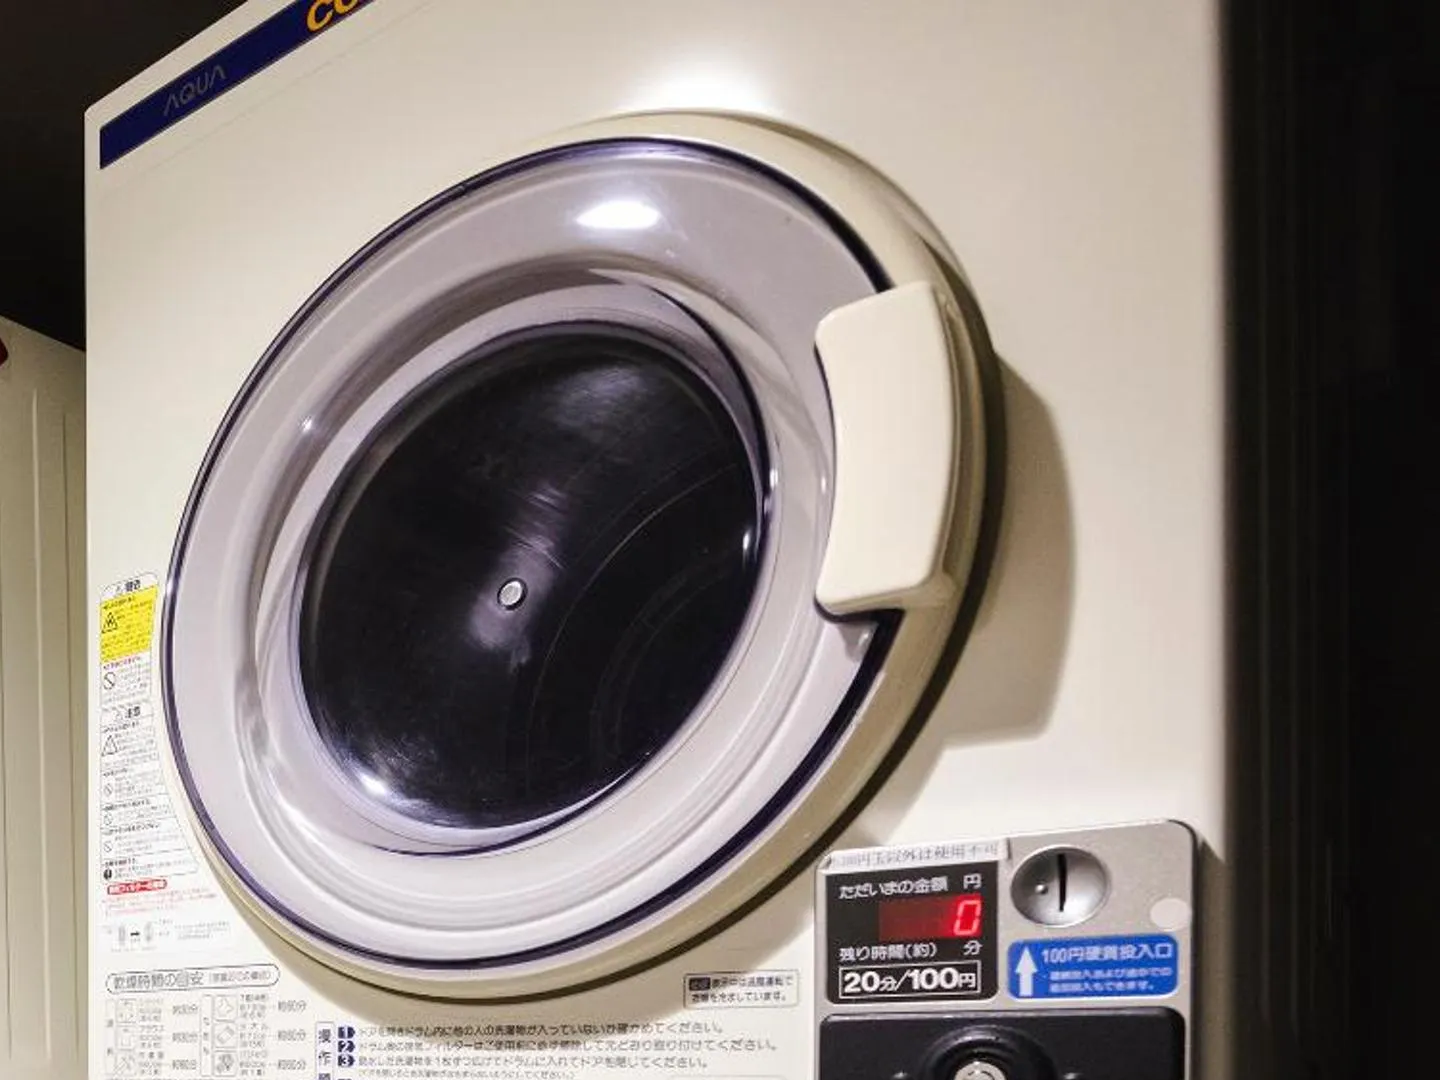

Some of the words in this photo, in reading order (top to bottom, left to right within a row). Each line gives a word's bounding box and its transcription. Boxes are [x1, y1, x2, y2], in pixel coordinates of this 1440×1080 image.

[163, 64, 227, 117] AQUA
[839, 876, 948, 899] ただいまの金額
[963, 873, 982, 889] 円
[953, 899, 982, 936] 0
[839, 942, 937, 962] 残り時間(約)
[963, 940, 982, 956] 分
[1042, 943, 1174, 964] 100円硬貨投入口
[843, 966, 978, 993] 20分/100円
